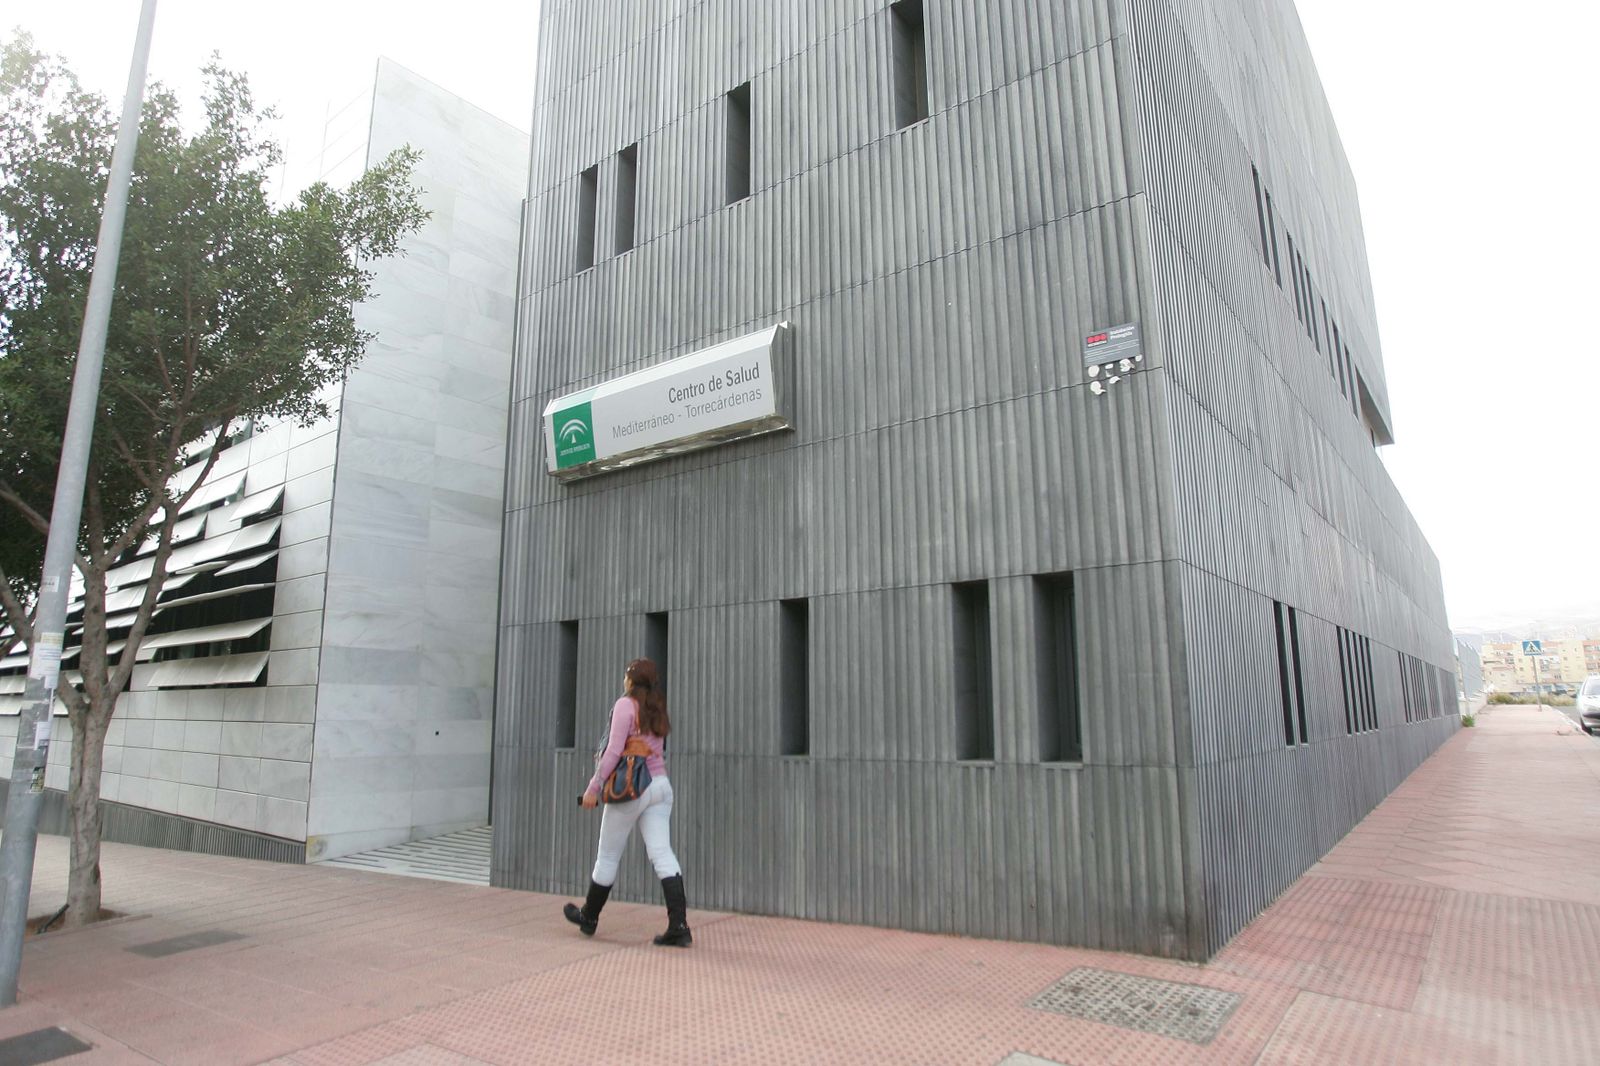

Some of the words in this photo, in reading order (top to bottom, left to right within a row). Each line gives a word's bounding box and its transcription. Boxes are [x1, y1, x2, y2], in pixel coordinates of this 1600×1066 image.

[668, 383, 705, 403] Centro
[708, 375, 723, 392] de
[726, 362, 760, 387] Salud
[612, 413, 675, 439] Mediterráneo
[685, 388, 762, 418] Torrecárdenas
